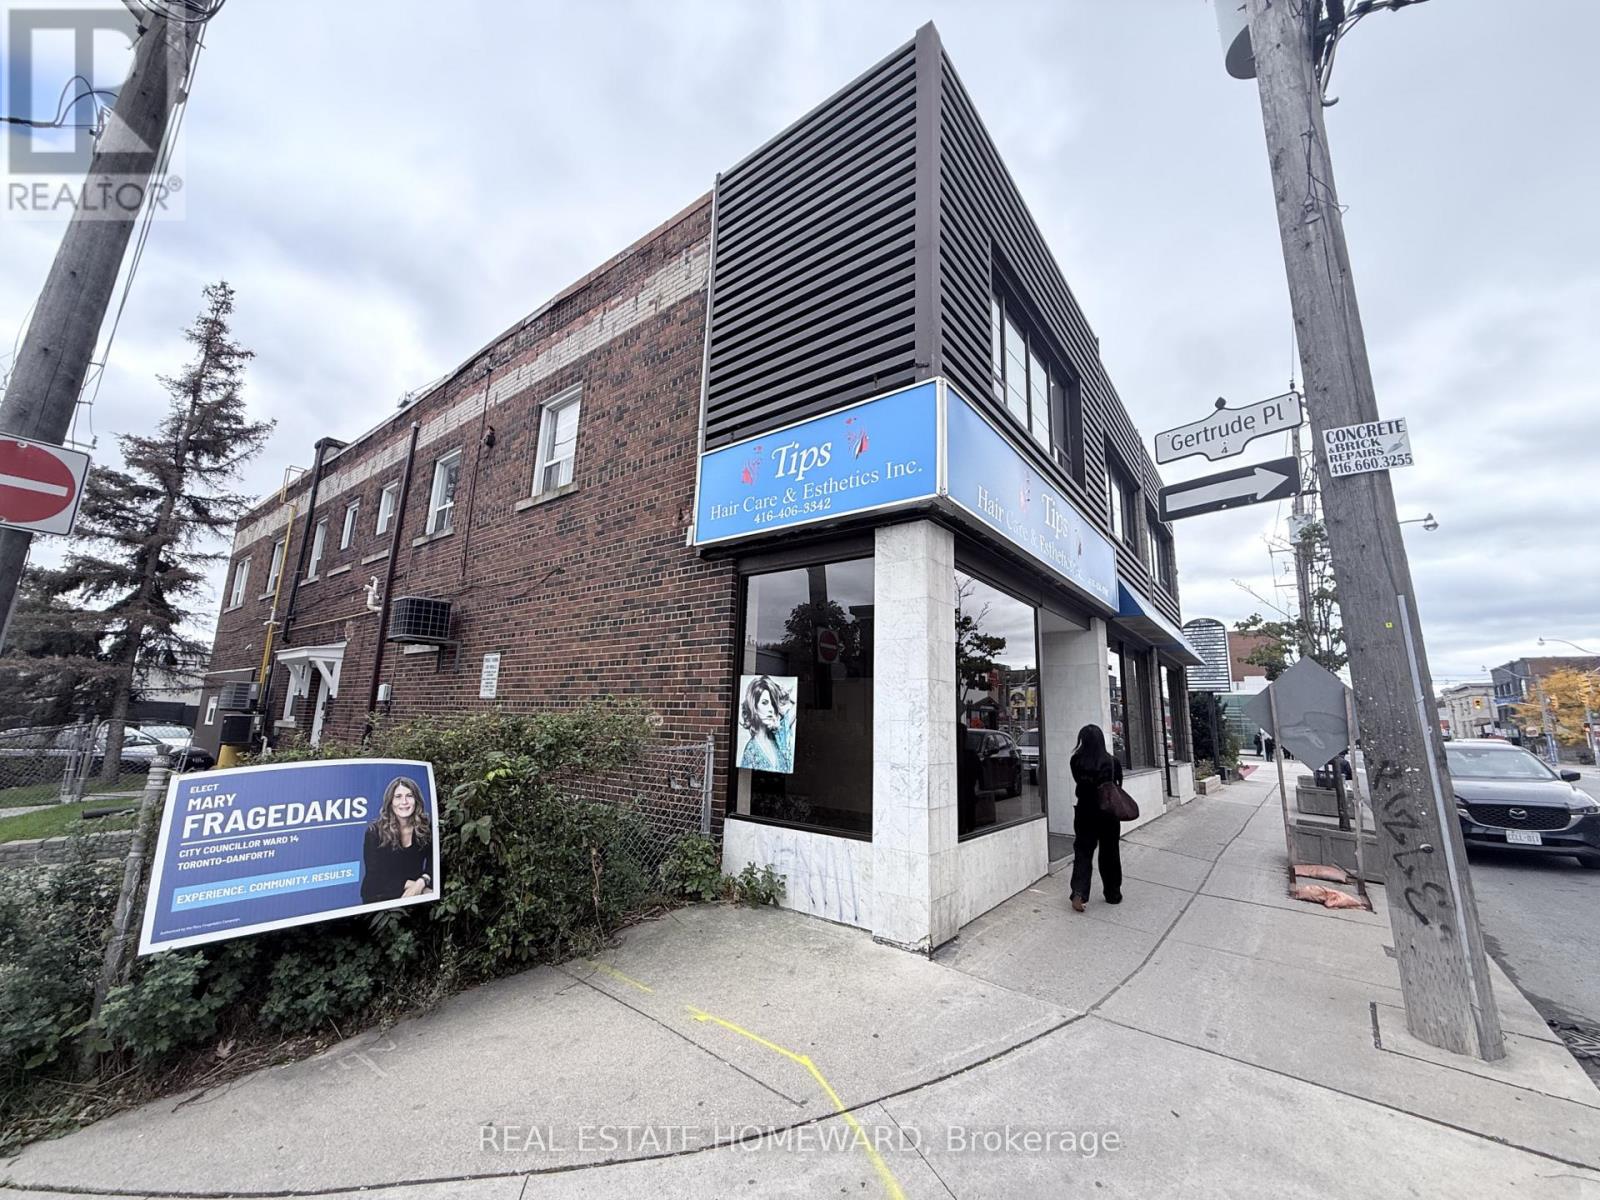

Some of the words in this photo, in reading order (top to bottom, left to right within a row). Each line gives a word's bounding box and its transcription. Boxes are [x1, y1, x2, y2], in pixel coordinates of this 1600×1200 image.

[1170, 414, 1256, 451] Gertrude
[1262, 402, 1284, 425] Pl
[1325, 419, 1406, 444] CONCRETE
[771, 440, 832, 482] Tips
[1329, 447, 1385, 463] REPAIRS
[1331, 452, 1413, 475] 416.660.3255
[710, 503, 740, 521] Hair
[743, 494, 778, 513] Care
[782, 487, 797, 505] &
[803, 468, 879, 499] Esthetics
[885, 459, 923, 479] Inc.
[977, 485, 1005, 522] Hair
[1041, 493, 1068, 540] Tips
[187, 793, 237, 812] MARY
[189, 783, 220, 794] ELECT
[182, 797, 368, 839] FRAGEDAKIS
[179, 847, 201, 858] CITY
[203, 840, 261, 855] COUNCILLOR
[262, 837, 288, 847] WARD
[289, 834, 299, 843] 14
[176, 884, 247, 905] EXPERIENCE.
[249, 875, 310, 893] COMMUNITY.
[311, 868, 354, 884] RESULTS.
